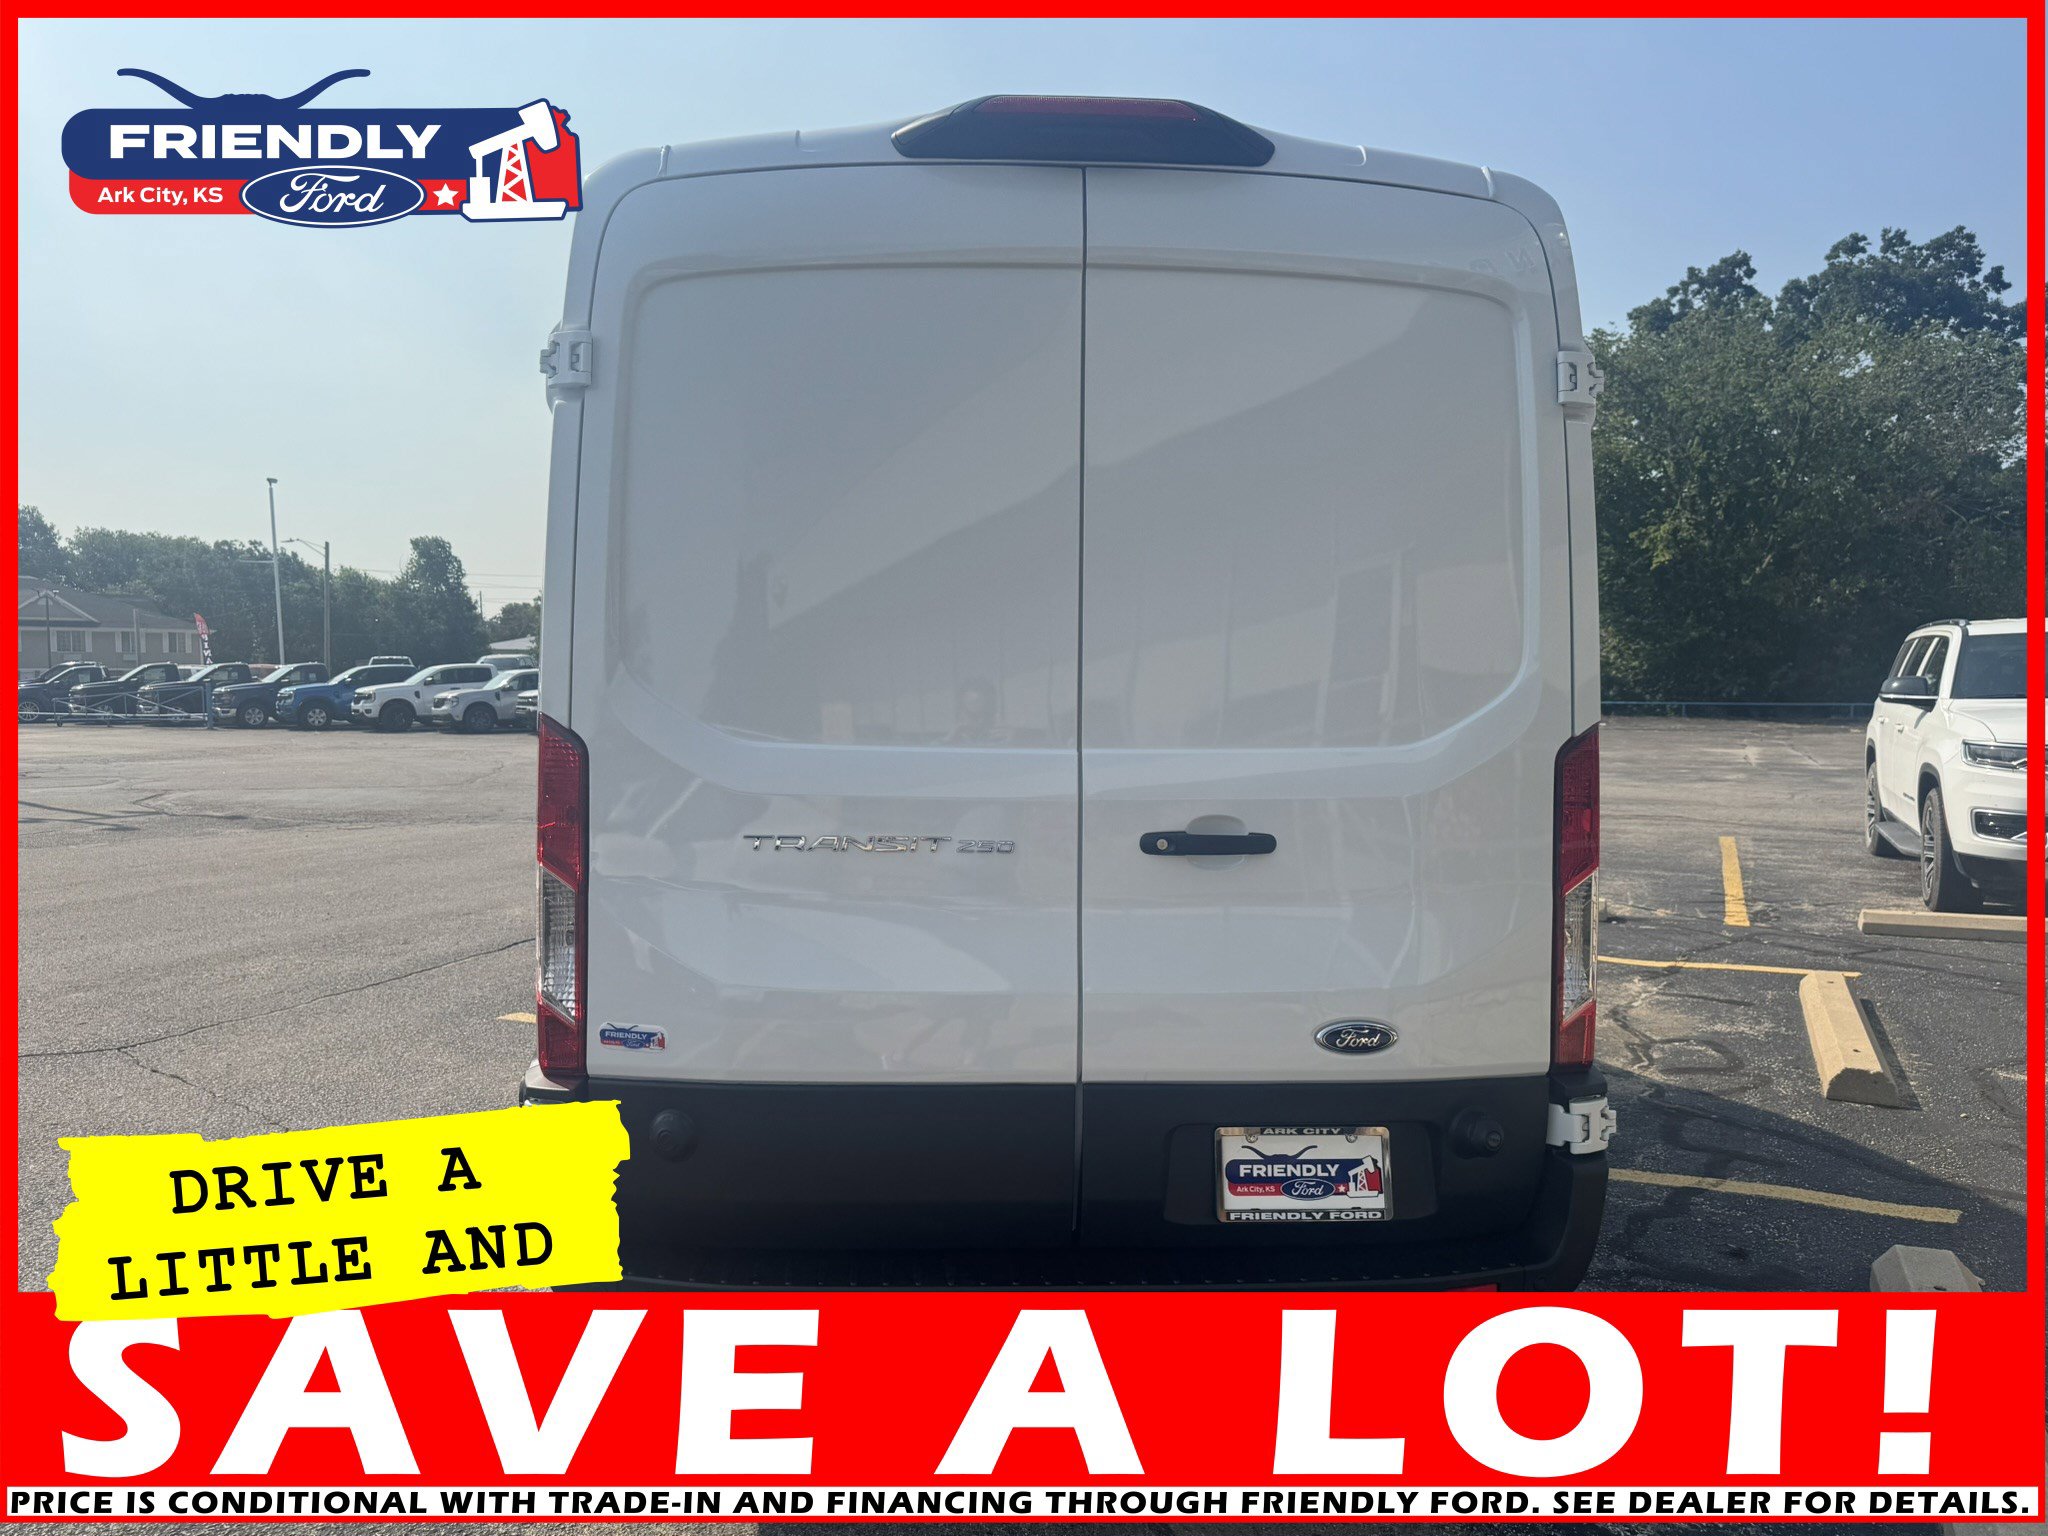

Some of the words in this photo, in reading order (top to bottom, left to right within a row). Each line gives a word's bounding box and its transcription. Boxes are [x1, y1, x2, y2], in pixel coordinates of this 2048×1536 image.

[743, 835, 952, 852] TRANSIT
[955, 840, 1016, 853] 250
[605, 1031, 648, 1039] FRIENDLY
[1336, 1029, 1381, 1047] Ford
[1239, 1164, 1340, 1177] FRIENDLY
[1236, 1185, 1249, 1193] Ark
[1249, 1185, 1265, 1194] City,
[1291, 1180, 1323, 1196] Ford
[1230, 1212, 1325, 1220] FRIENDLY
[1330, 1211, 1381, 1219] FORD
